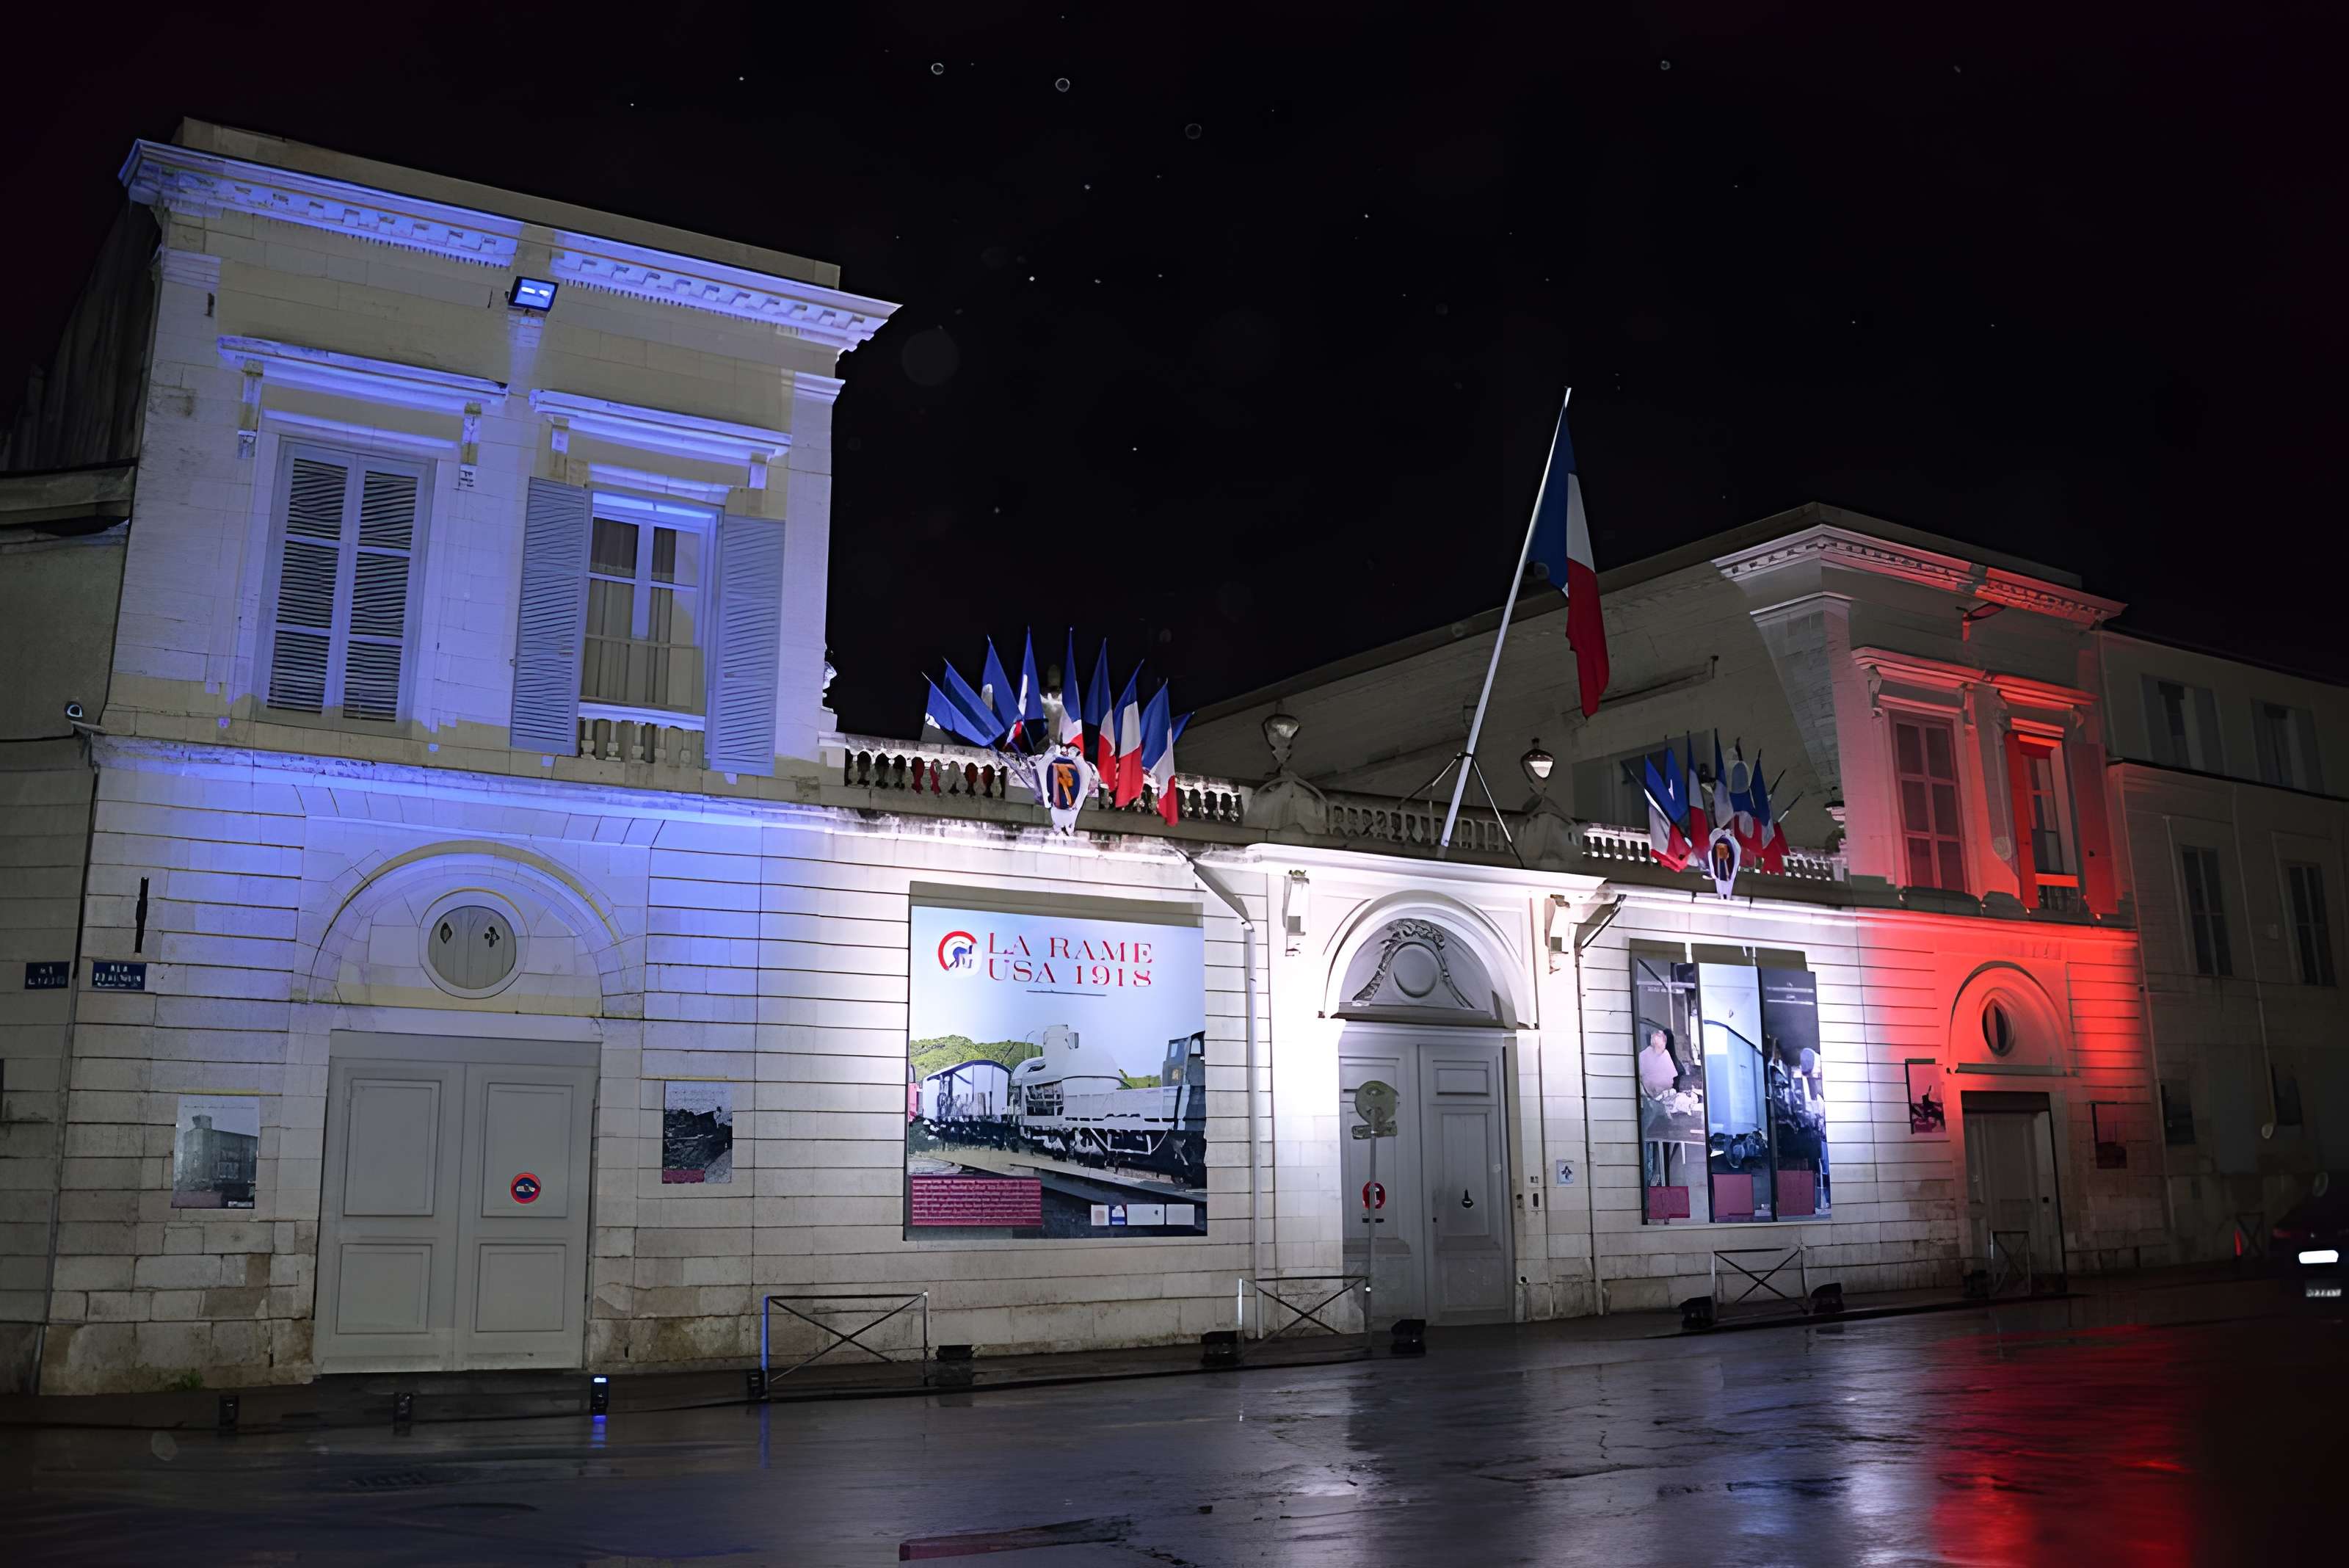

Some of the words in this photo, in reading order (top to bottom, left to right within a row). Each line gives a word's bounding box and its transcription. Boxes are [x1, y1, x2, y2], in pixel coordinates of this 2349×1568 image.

[989, 932, 1031, 957] LA
[1050, 937, 1152, 963] RAME
[989, 958, 1056, 983] USA
[1076, 965, 1152, 987] 1918
